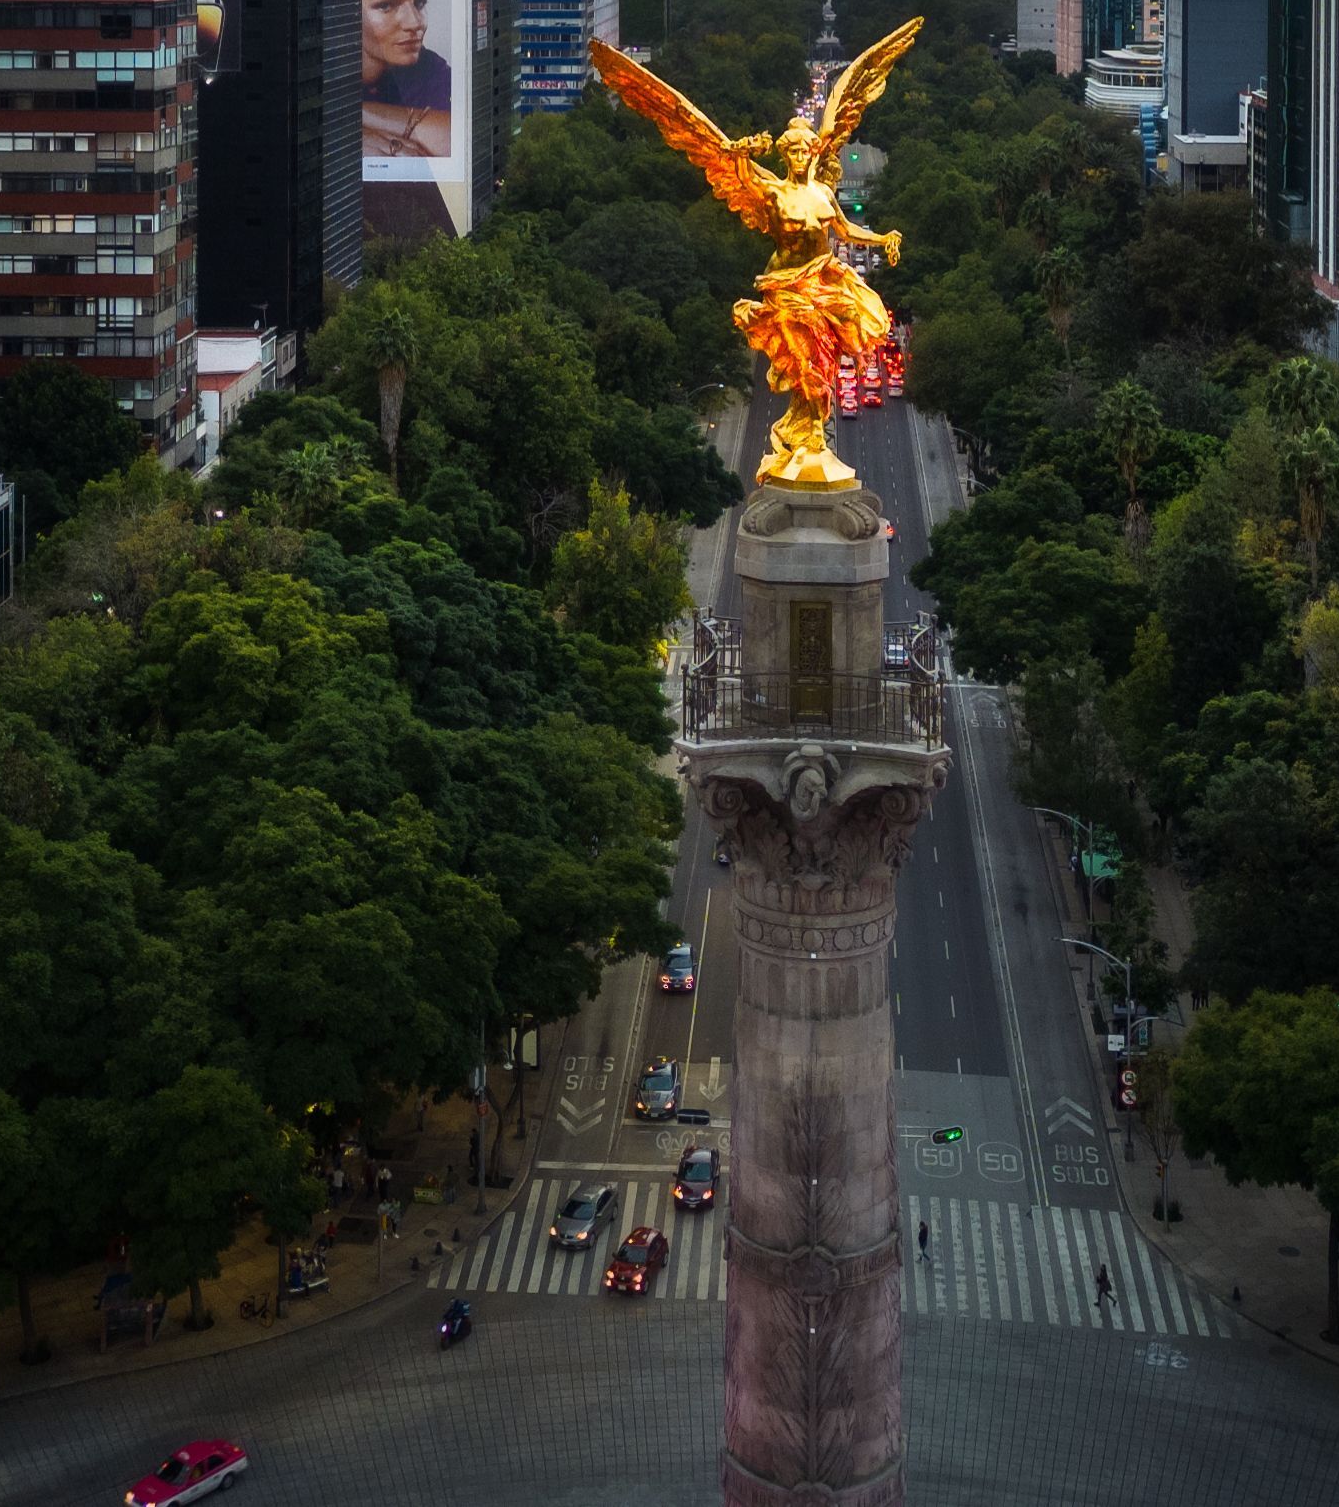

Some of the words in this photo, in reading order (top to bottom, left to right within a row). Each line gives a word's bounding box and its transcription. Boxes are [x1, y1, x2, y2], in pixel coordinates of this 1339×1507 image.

[564, 1056, 616, 1072] SLO
[923, 1148, 955, 1166] 50
[984, 1152, 1018, 1172] 50
[1055, 1144, 1099, 1163] BUS
[1052, 1164, 1109, 1185] SOLO
